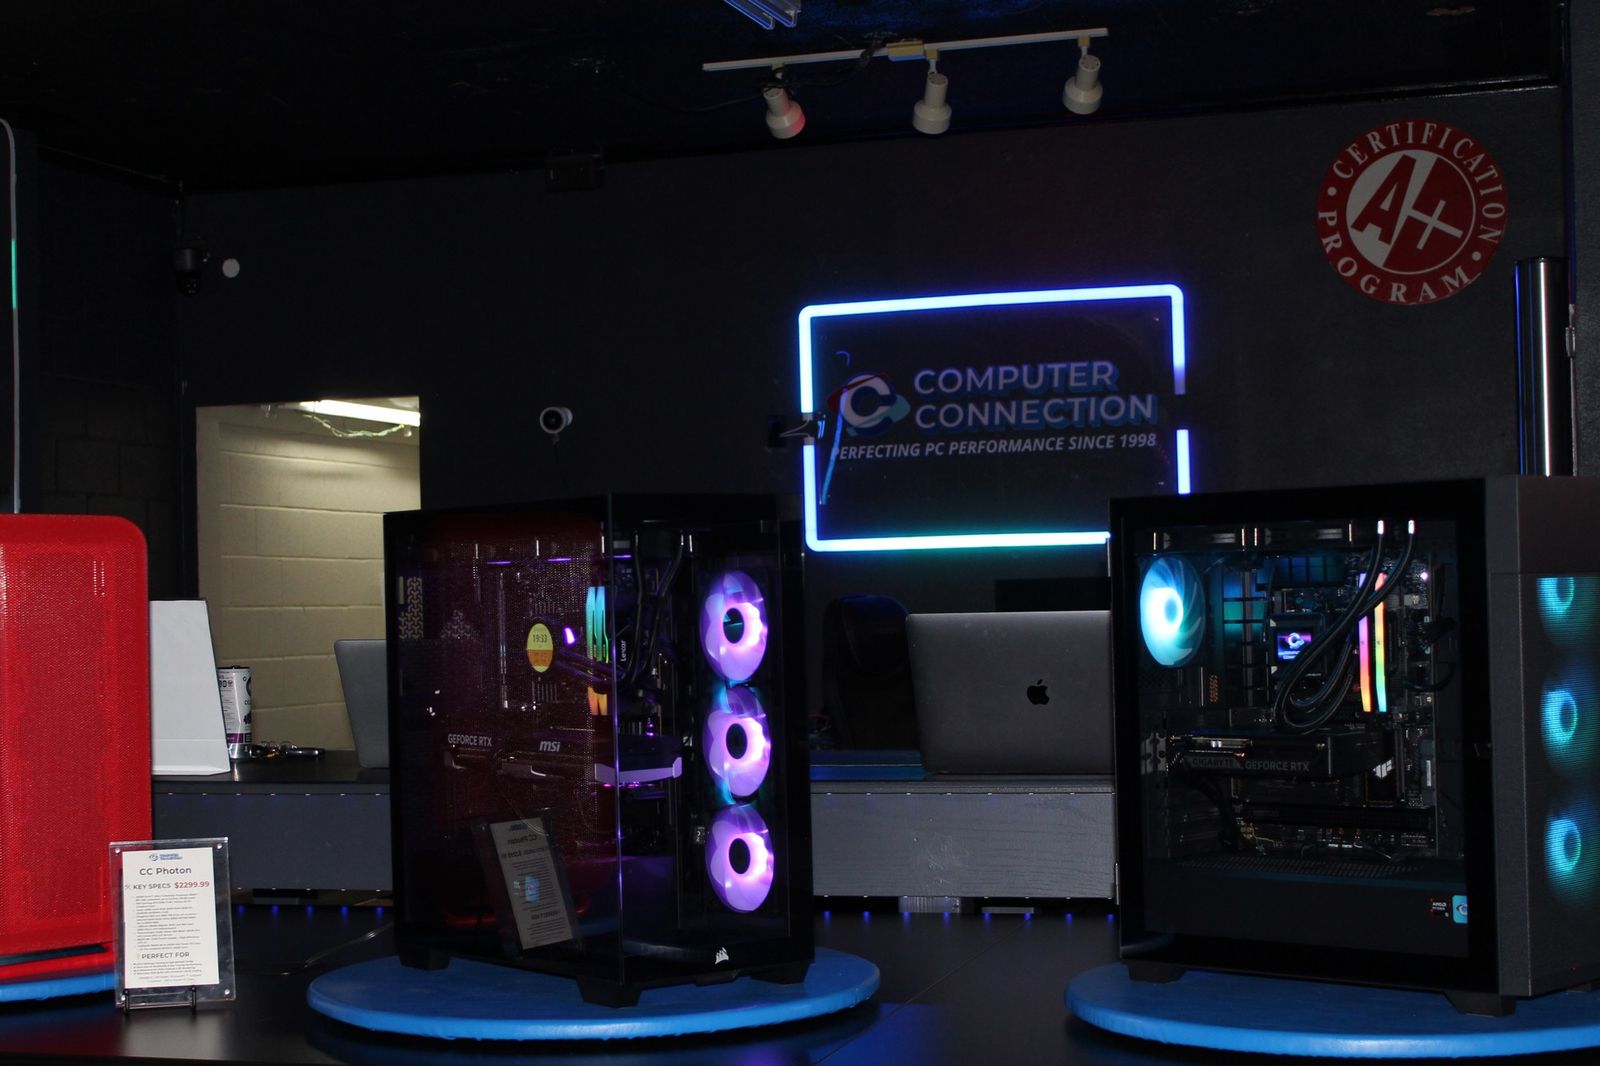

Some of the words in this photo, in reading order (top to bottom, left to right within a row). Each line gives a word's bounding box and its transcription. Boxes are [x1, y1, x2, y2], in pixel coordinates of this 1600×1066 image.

[1332, 121, 1505, 244] CERTIFICATION
[1351, 154, 1464, 250] A+
[1318, 208, 1471, 302] PROGRAM
[914, 360, 1116, 395] COMPUTER
[915, 394, 1155, 430] CONNECTION
[925, 442, 945, 456] PC
[948, 437, 1065, 455] PERFORMANCE
[1068, 434, 1115, 450] SINCE
[1119, 433, 1157, 448] 1998
[447, 733, 478, 746] GEFORCE
[478, 735, 492, 747] RTX
[539, 740, 561, 752] msi
[1244, 760, 1289, 771] GEFORCE
[1290, 761, 1310, 772] RTX
[139, 868, 153, 876] CC
[156, 867, 192, 875] Photon
[174, 880, 210, 889] $2299.99
